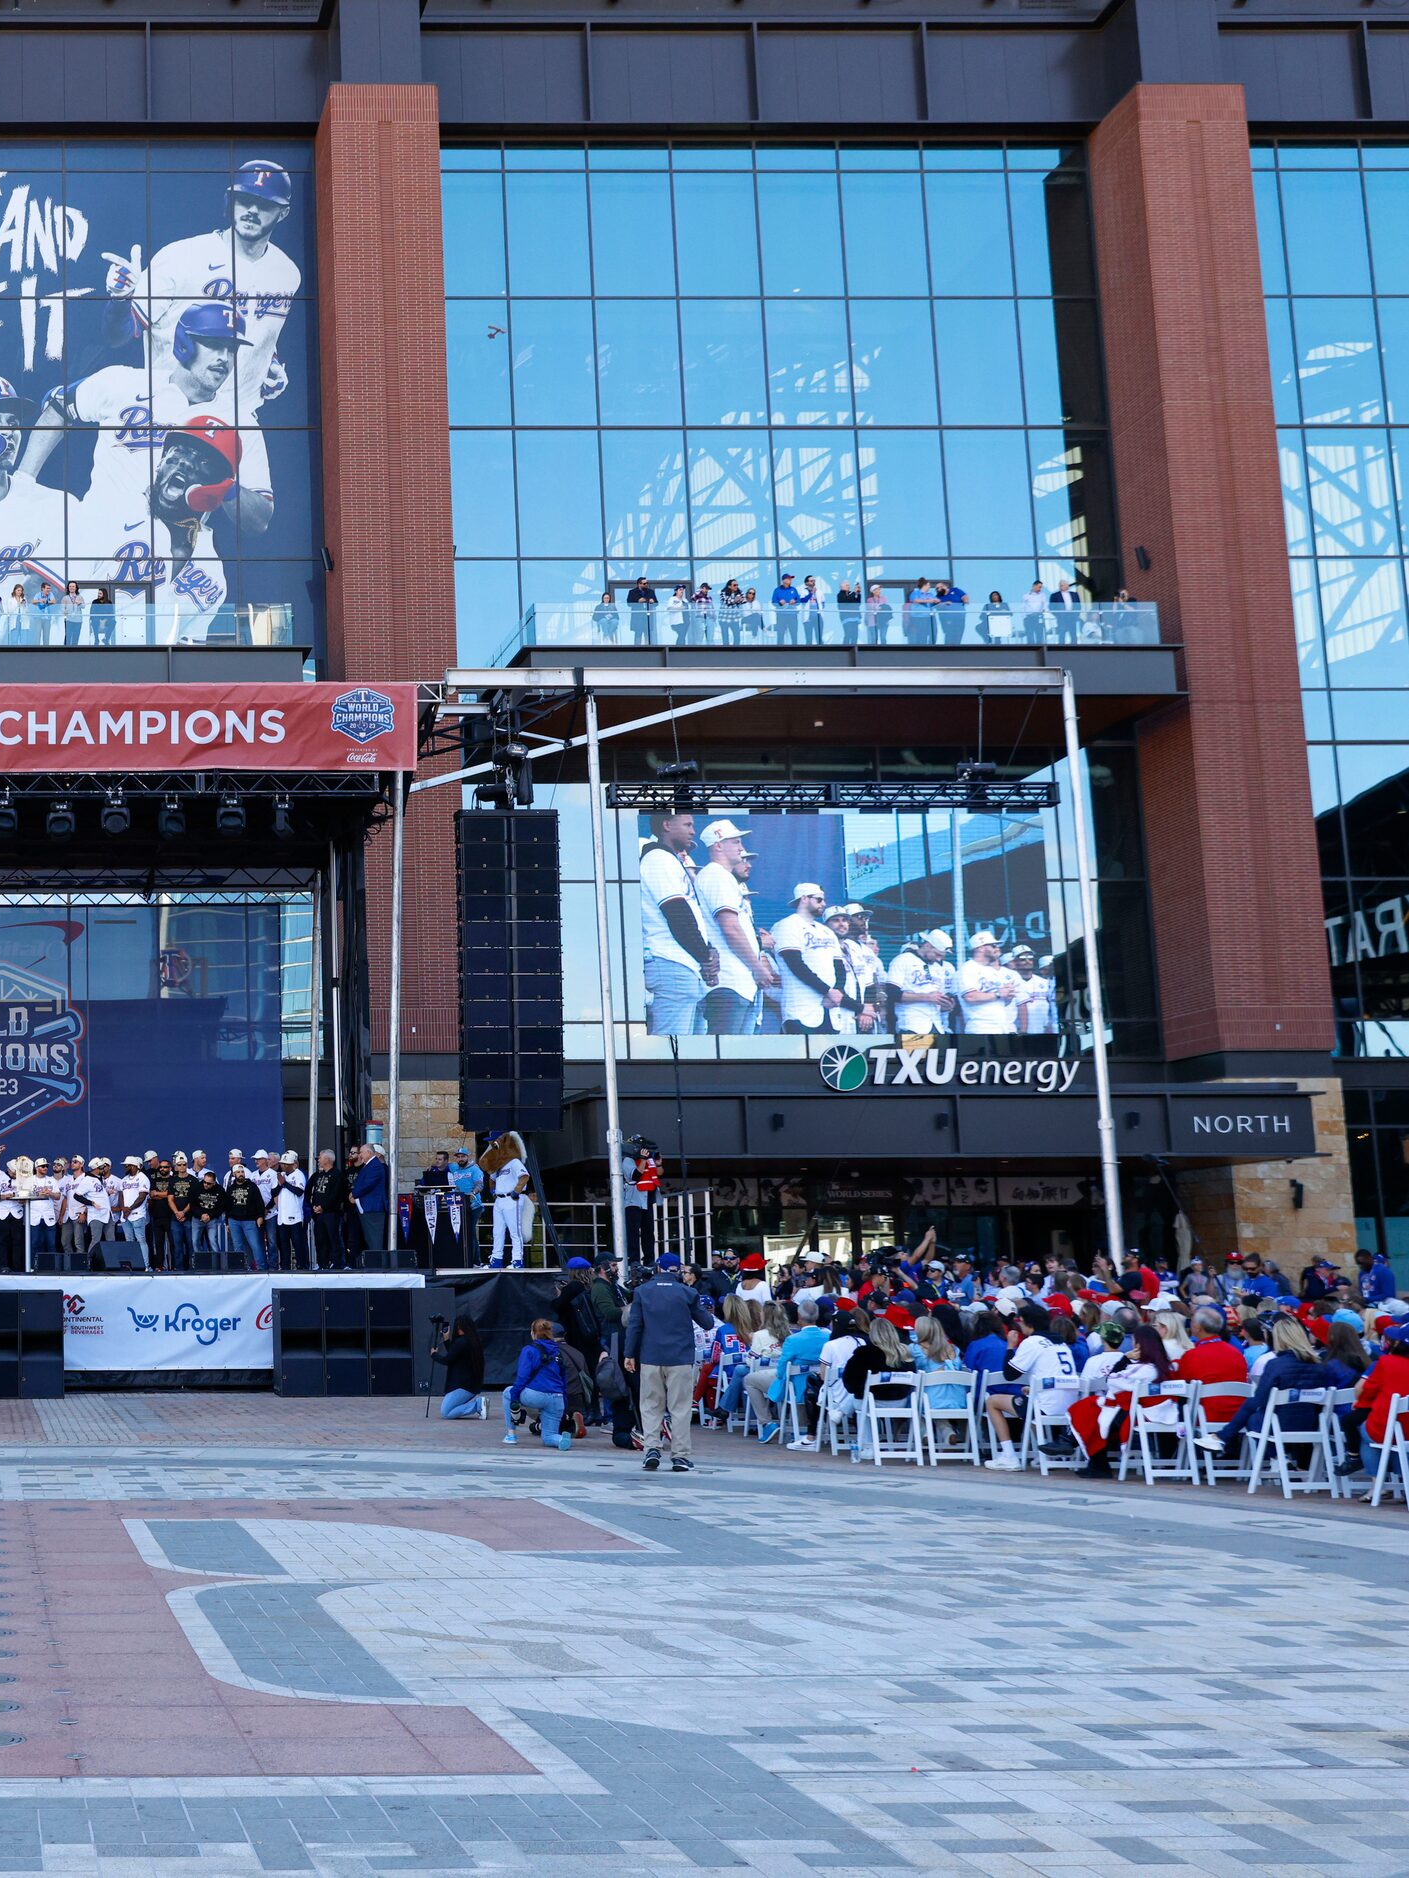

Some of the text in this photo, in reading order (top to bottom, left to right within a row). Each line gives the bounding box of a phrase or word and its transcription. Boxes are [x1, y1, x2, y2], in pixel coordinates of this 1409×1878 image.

[20, 275, 96, 373] IT
[357, 690, 369, 702] T
[336, 713, 390, 723] CHAMPIONS
[348, 703, 379, 712] WORLD
[869, 1048, 1080, 1092] TXU energy
[1193, 1114, 1291, 1134] NORTH
[165, 1302, 242, 1346] Kroger
[1056, 1351, 1073, 1375] 5
